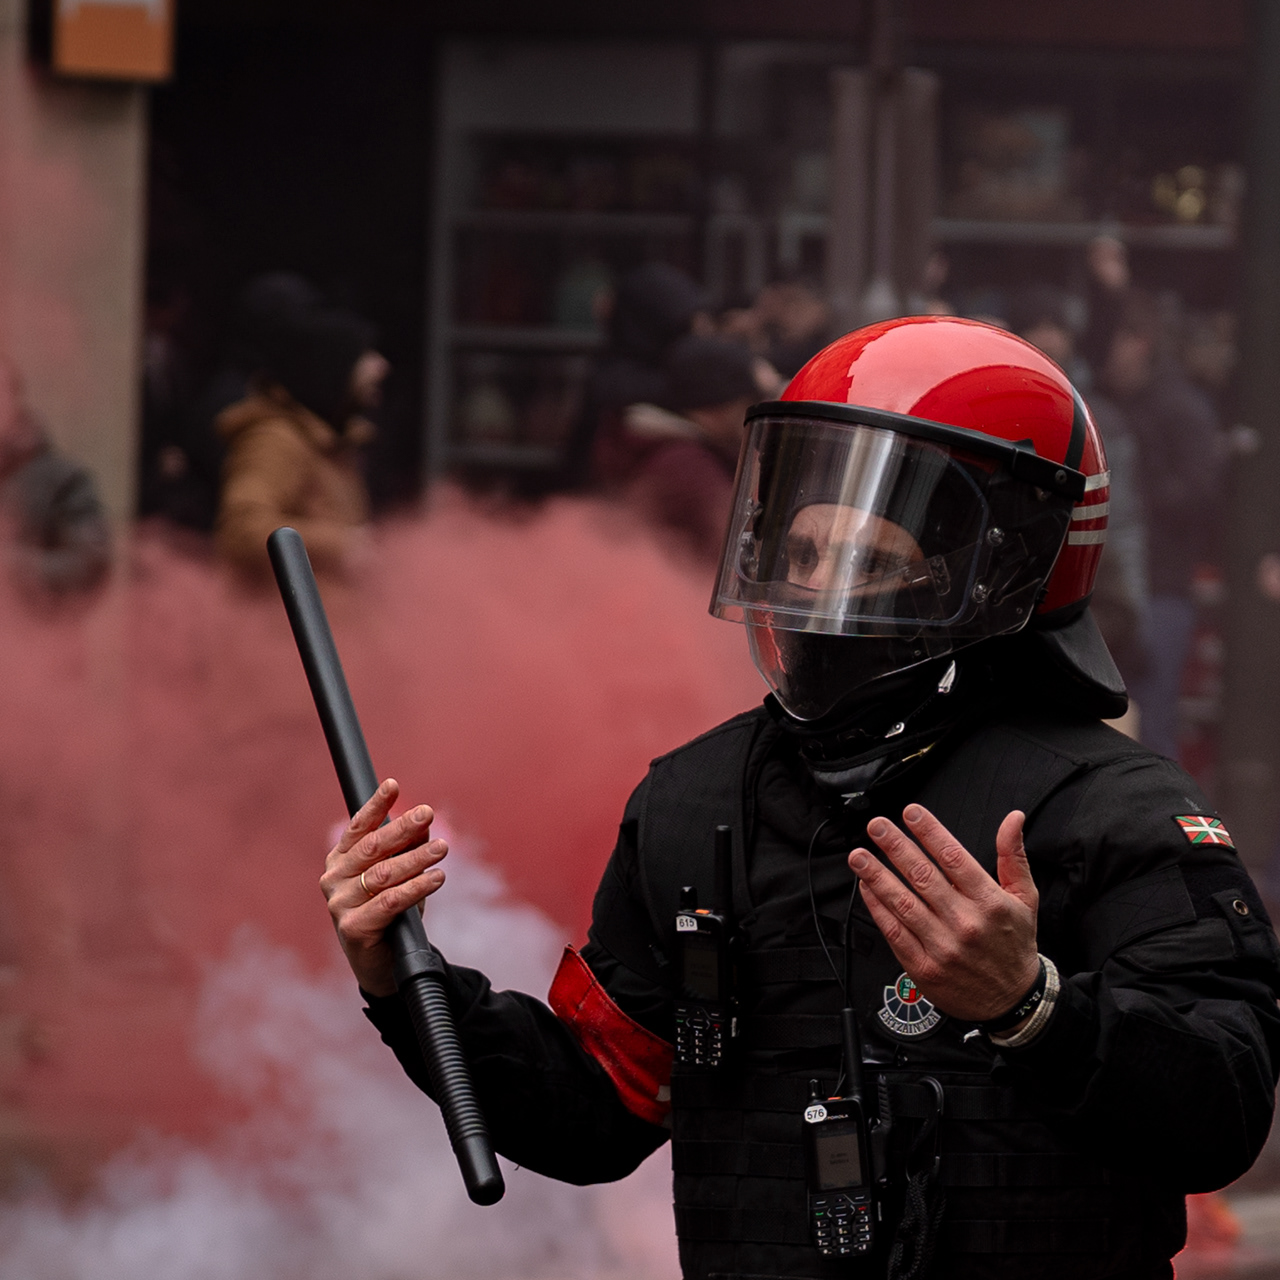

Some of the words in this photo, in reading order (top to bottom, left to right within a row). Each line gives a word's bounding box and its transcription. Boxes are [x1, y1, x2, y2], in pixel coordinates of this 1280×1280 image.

[679, 918, 695, 928] 615
[880, 1010, 939, 1034] ERTZAINTZA
[807, 1108, 825, 1120] 576
